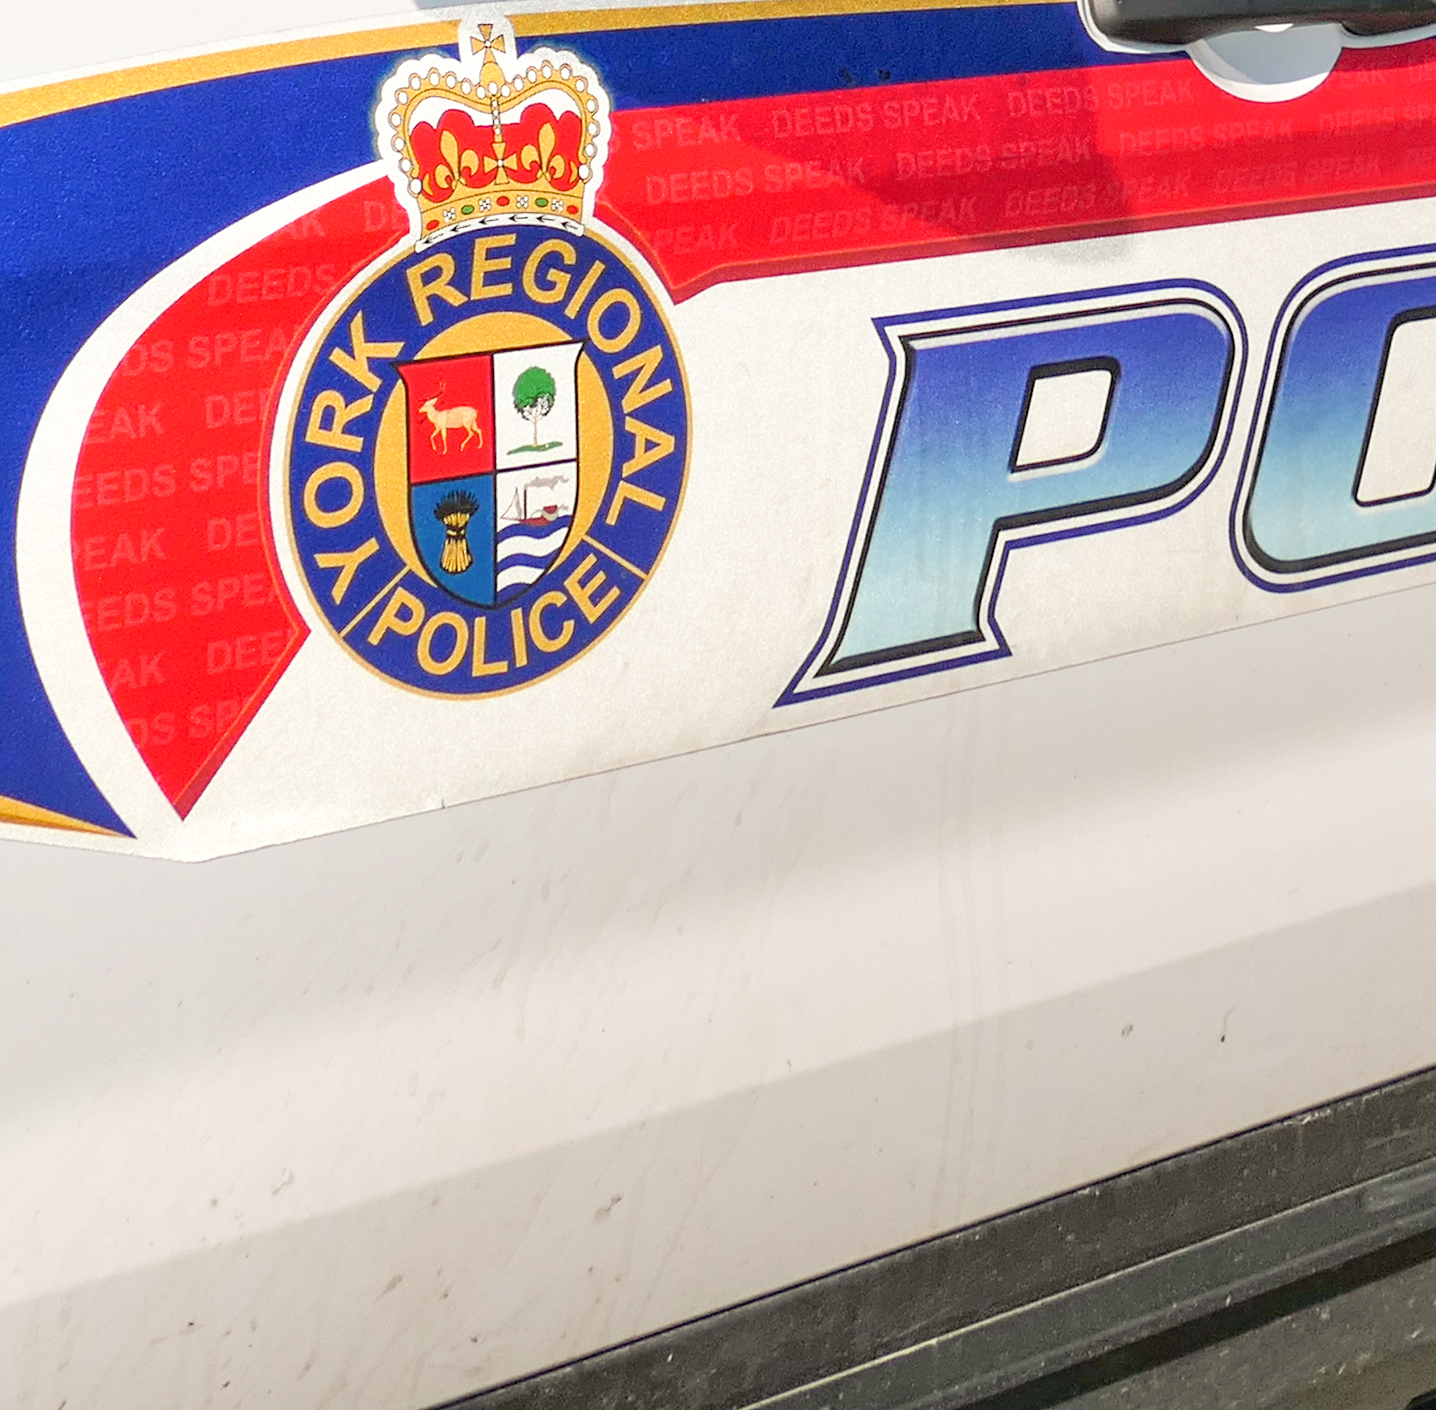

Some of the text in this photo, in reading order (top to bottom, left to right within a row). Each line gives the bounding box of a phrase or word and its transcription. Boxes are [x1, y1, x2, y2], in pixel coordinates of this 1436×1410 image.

[631, 113, 741, 152] SPEAK
[770, 101, 874, 140] DEEDS
[882, 92, 982, 131] SPEAK
[1006, 85, 1100, 119] DEEDS
[1107, 77, 1194, 111] SPEAK
[645, 166, 754, 206] DEEDS
[764, 157, 865, 194] SPEAK
[896, 144, 992, 182] DEEDS
[644, 219, 741, 254] PEAK
[769, 206, 872, 245] DEEDS
[882, 194, 978, 233] SPEAK
[406, 233, 676, 528] REGIONAL
[303, 309, 406, 604] YORK
[72, 527, 165, 571] EAK
[368, 553, 622, 677] POLICE
